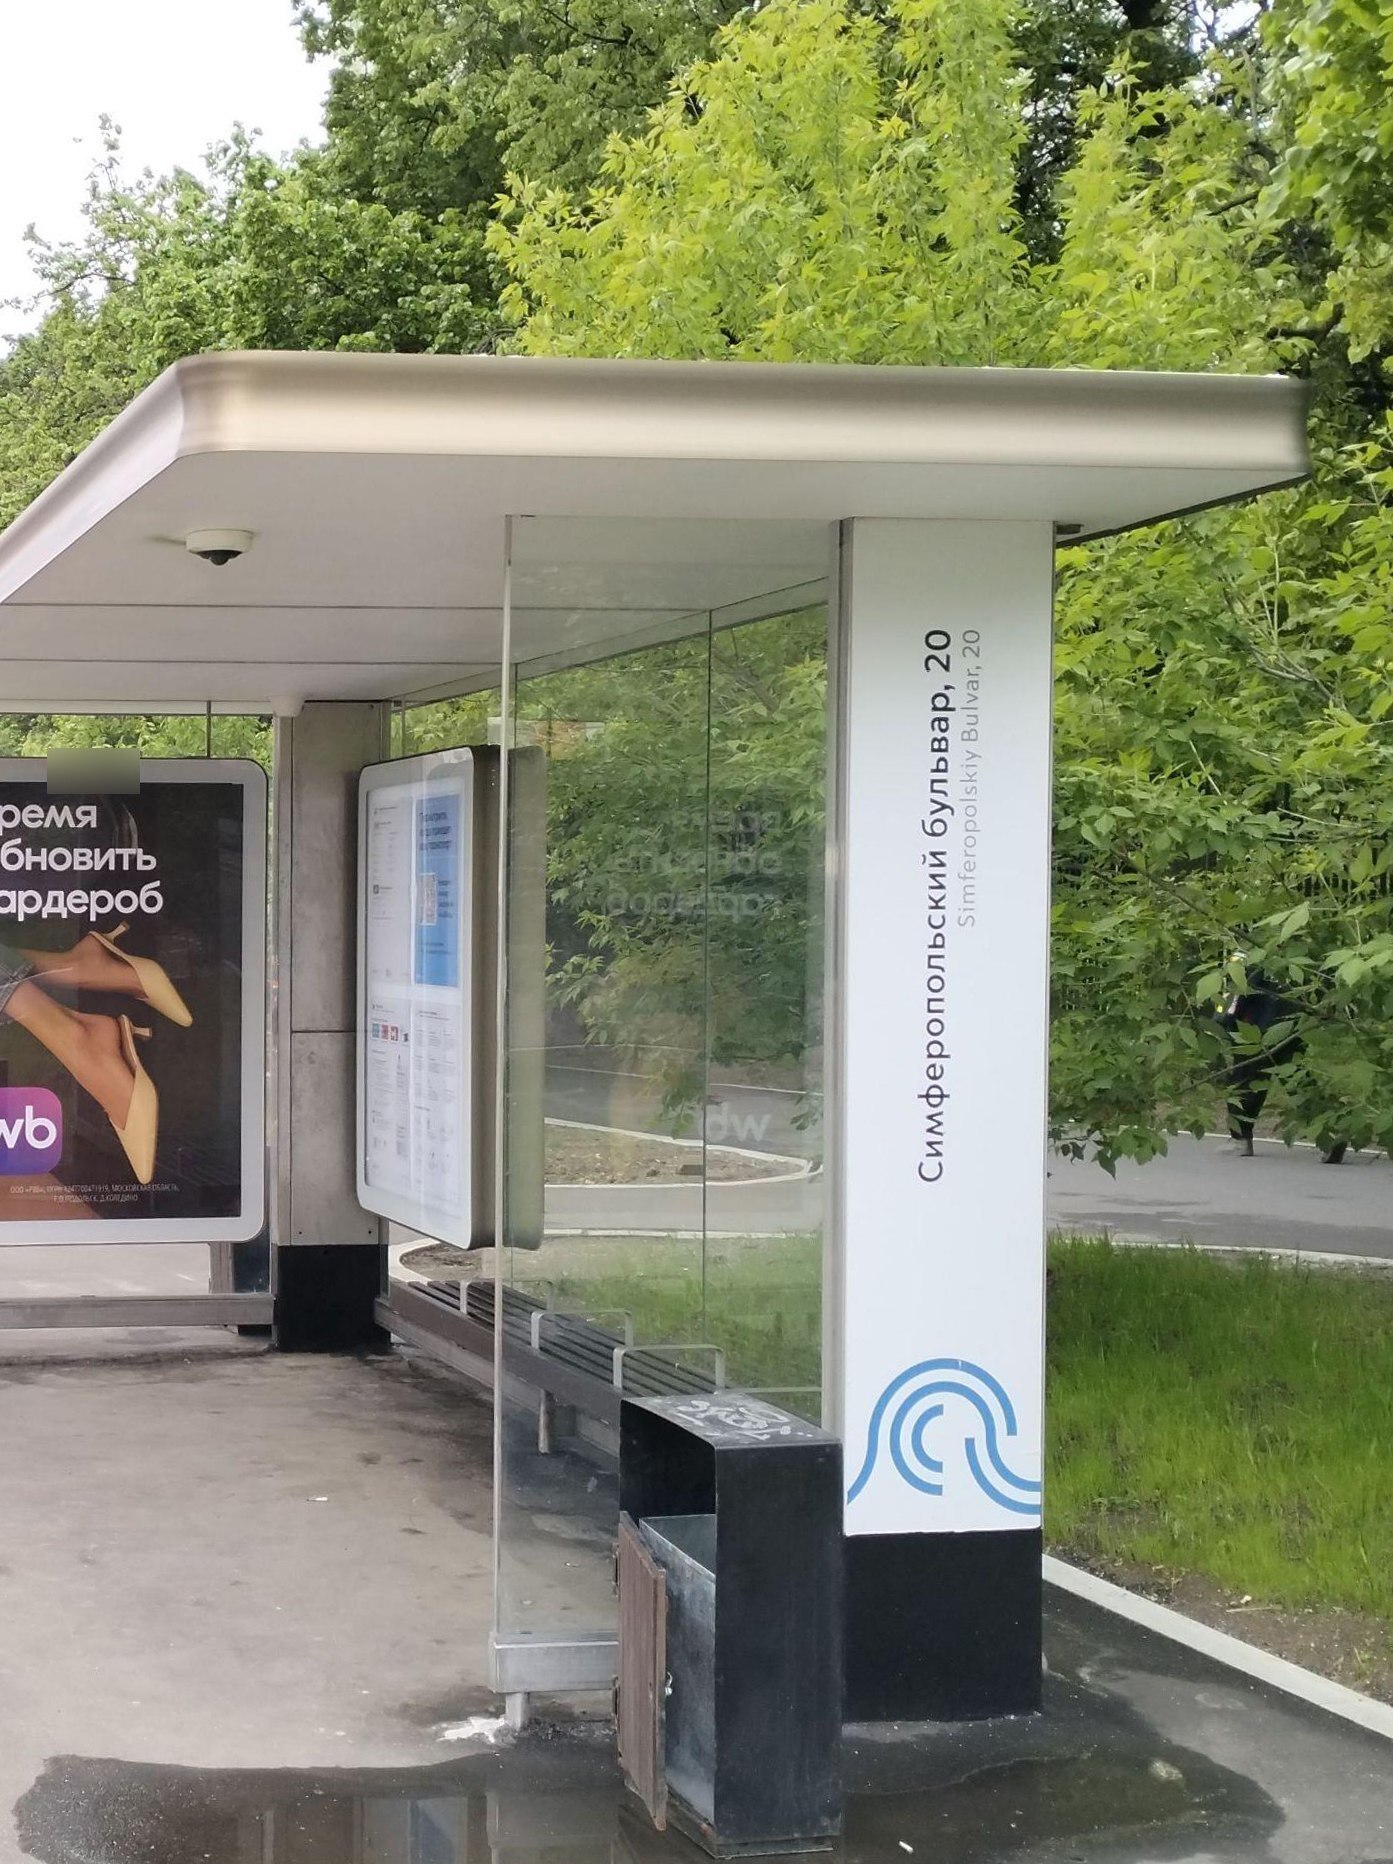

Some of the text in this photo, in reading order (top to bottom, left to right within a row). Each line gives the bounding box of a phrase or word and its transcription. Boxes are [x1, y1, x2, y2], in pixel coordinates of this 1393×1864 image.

[917, 629, 956, 1183] Симферопольский бульвар, 20
[957, 629, 983, 928] Simferopolskiy Bulvar, 20
